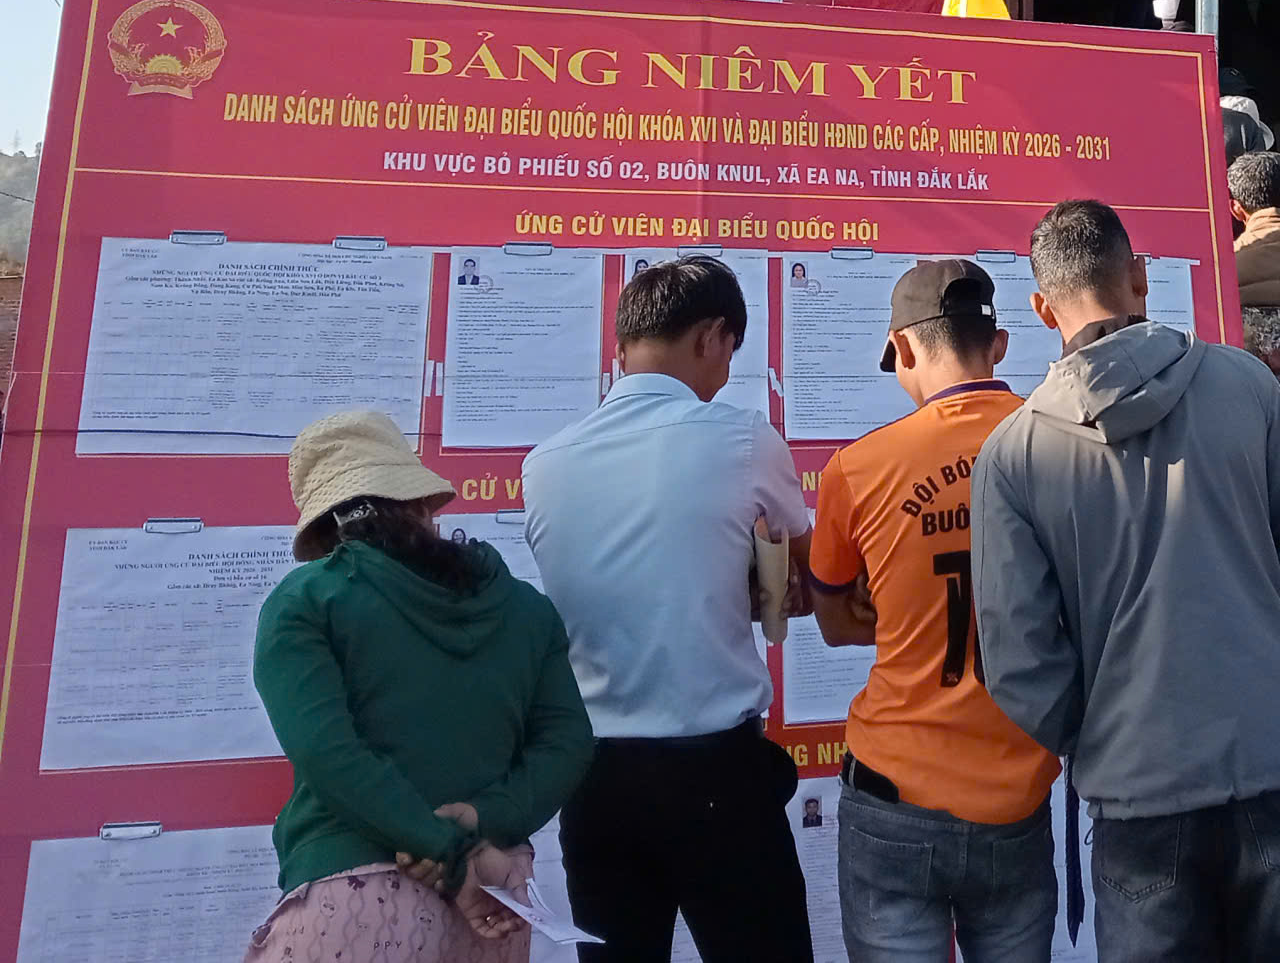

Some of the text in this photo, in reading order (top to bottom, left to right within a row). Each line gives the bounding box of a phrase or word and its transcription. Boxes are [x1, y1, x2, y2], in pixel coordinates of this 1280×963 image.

[404, 31, 976, 104] BẢNG NIÊM YẾT
[223, 93, 278, 123] DANH
[282, 89, 335, 126] SÁCH
[340, 92, 379, 128] ỨNG
[384, 93, 413, 131] CỬ
[417, 97, 459, 132] VIÊN
[463, 106, 496, 141] ĐẠI
[500, 97, 543, 137] BIỂU
[548, 102, 597, 140] QUỐC
[602, 107, 633, 146] HỘI
[639, 108, 685, 142] KHÓA
[689, 115, 717, 143] XVI
[722, 112, 744, 144] VÀ
[748, 119, 777, 151] ĐẠI
[782, 109, 819, 148] BIỂU
[824, 122, 868, 149] HĐND
[872, 119, 904, 151] CÁC
[909, 121, 945, 157] CẤP,
[949, 128, 998, 160] NHIỆM
[1002, 125, 1021, 156] KỲ
[1024, 132, 1061, 158] 2026
[1076, 134, 1110, 161] 2031
[383, 151, 989, 191] KHU VỰC BỎ PHIẾU SỐ 02, BUÔN KNUL, XÃ EA NA, TỈNH ĐẮK LẮK
[515, 209, 879, 245] ỨNG CỬ VIÊN ĐẠI BIỂU QUỐC HỘI
[462, 472, 498, 501] CỬ
[900, 475, 940, 518] ĐỘI
[921, 502, 971, 536] BUÔ
